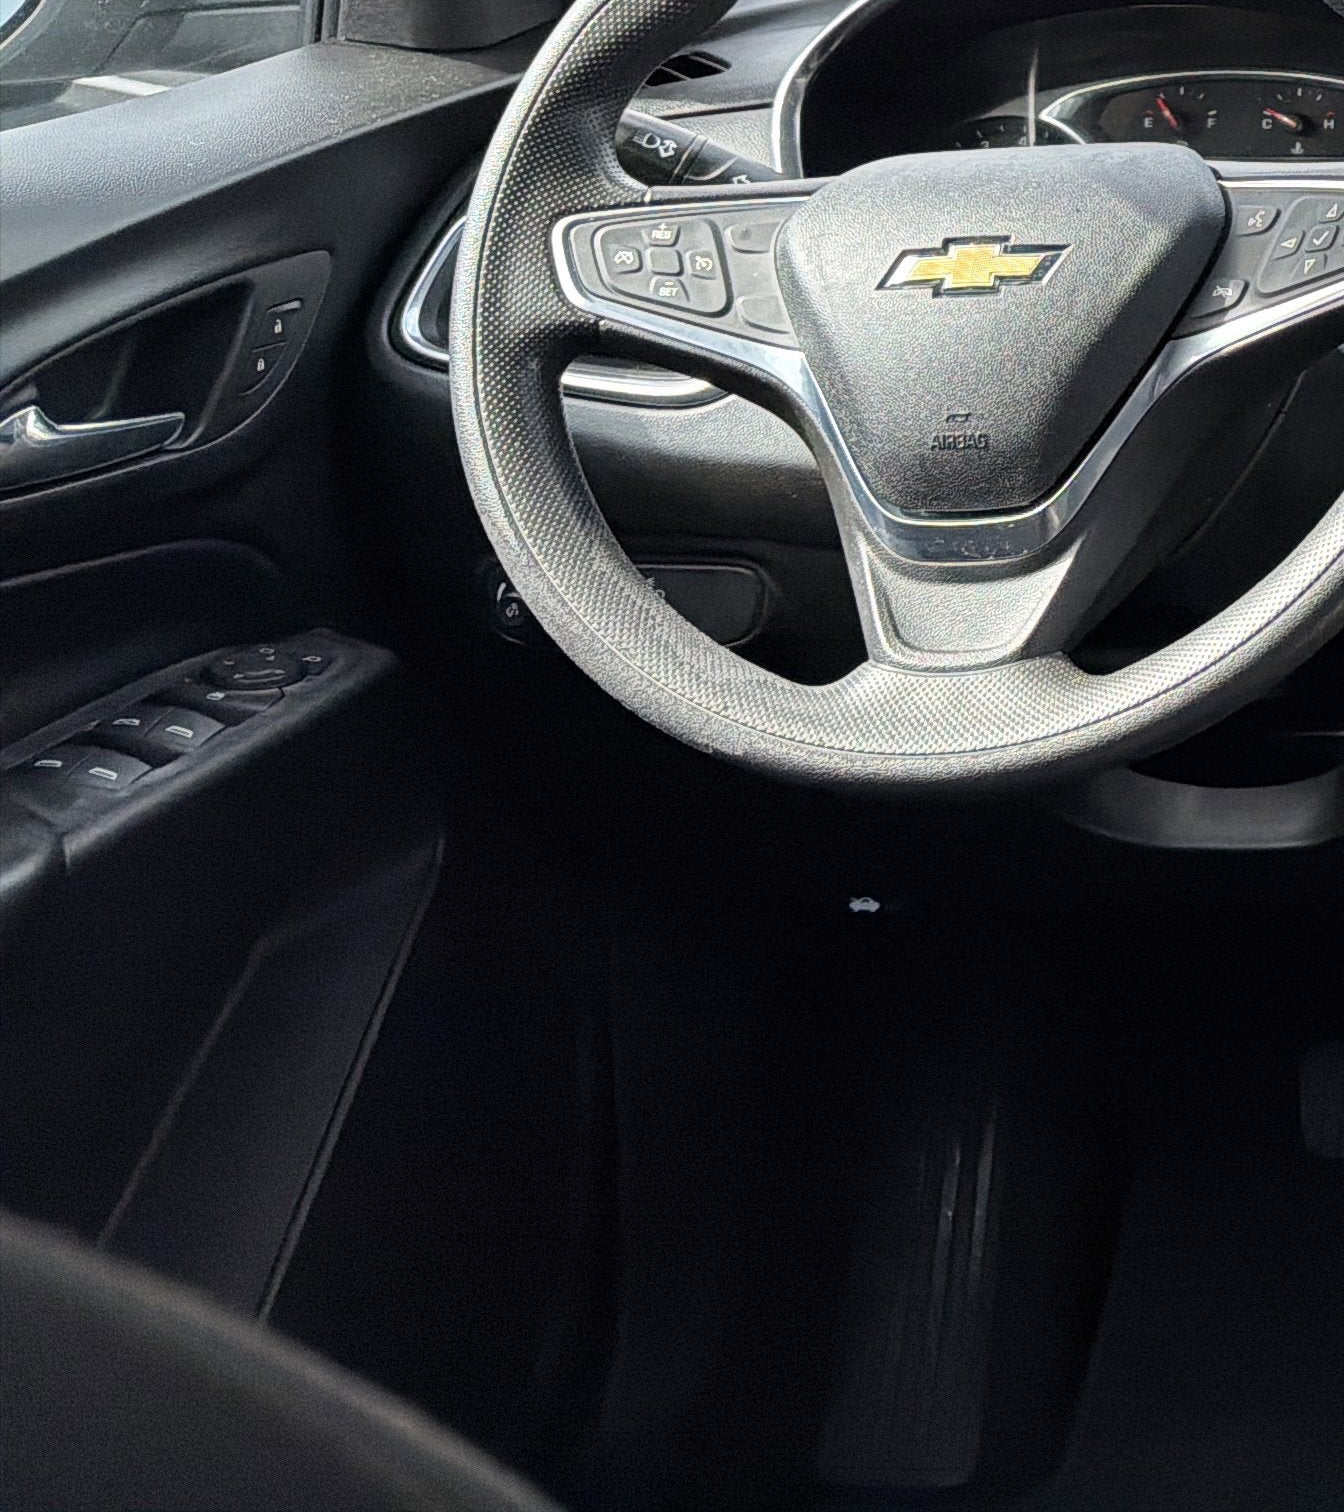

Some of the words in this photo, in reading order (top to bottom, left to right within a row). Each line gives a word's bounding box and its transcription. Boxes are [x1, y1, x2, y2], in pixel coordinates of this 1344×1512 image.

[1143, 117, 1153, 128] E
[1207, 118, 1217, 128] F
[1262, 118, 1273, 129] C
[1323, 119, 1335, 129] H
[651, 230, 673, 240] RES
[659, 286, 680, 296] SET
